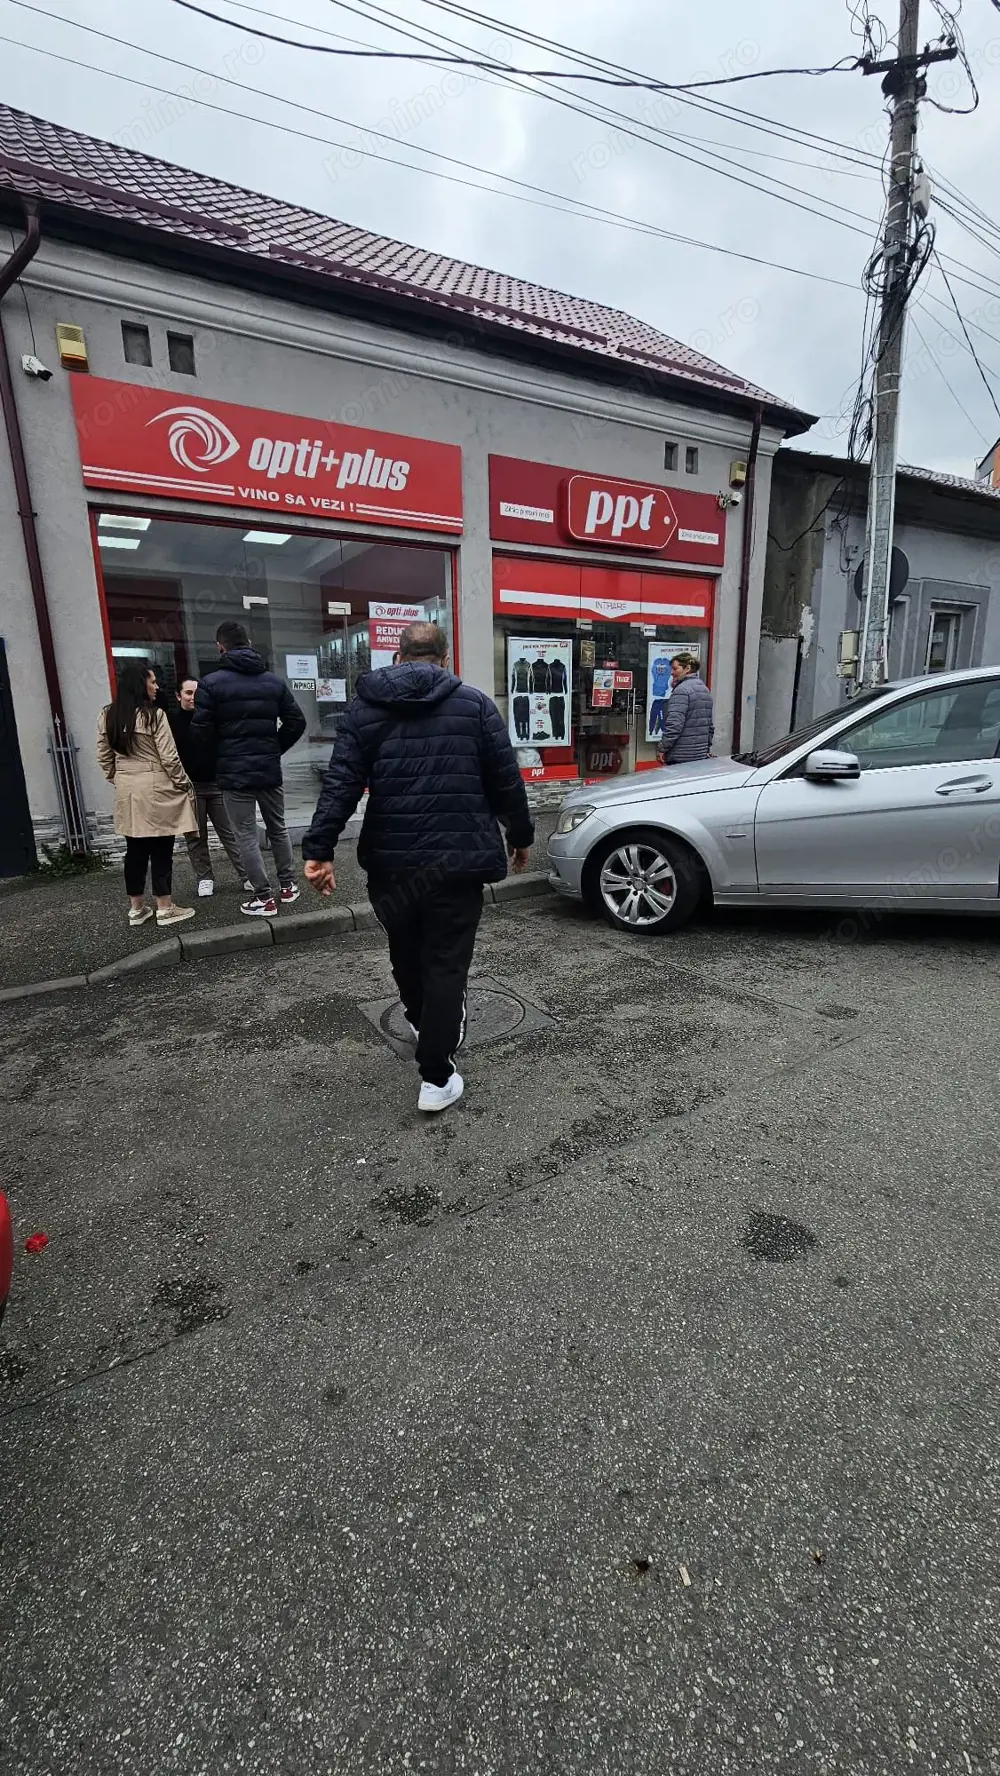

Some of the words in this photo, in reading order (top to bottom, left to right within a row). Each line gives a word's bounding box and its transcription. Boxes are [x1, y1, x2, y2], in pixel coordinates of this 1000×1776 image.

[249, 437, 410, 491] opti+plus
[238, 486, 280, 502] VINO
[285, 493, 306, 506] SA
[310, 496, 345, 511] VEZI
[585, 490, 656, 537] ppt
[596, 601, 626, 611] INTRARE
